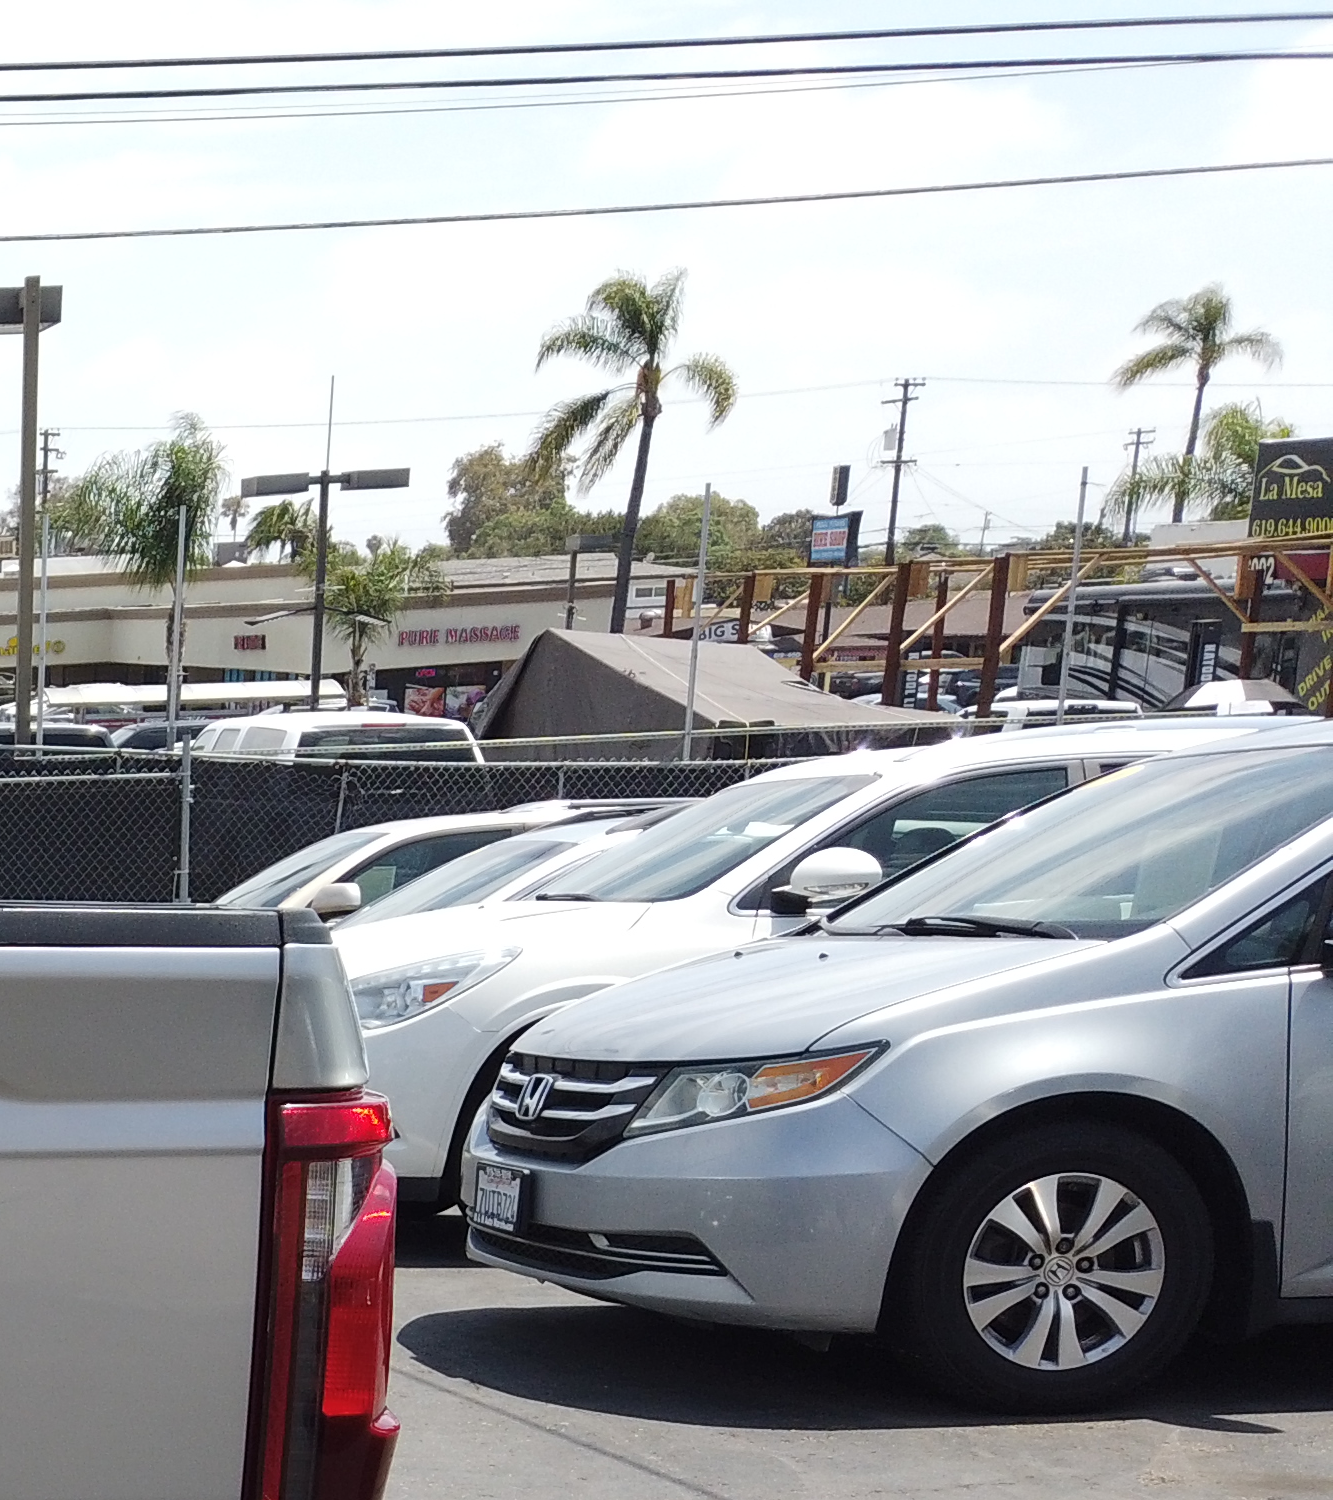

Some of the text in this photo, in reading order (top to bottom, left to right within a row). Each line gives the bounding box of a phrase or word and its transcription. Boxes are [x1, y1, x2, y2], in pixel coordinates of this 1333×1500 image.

[1259, 476, 1323, 500] La Mesa
[398, 624, 520, 646] PURE MASSAGE
[1298, 655, 1333, 697] DRIVE
[1308, 679, 1331, 711] OUT
